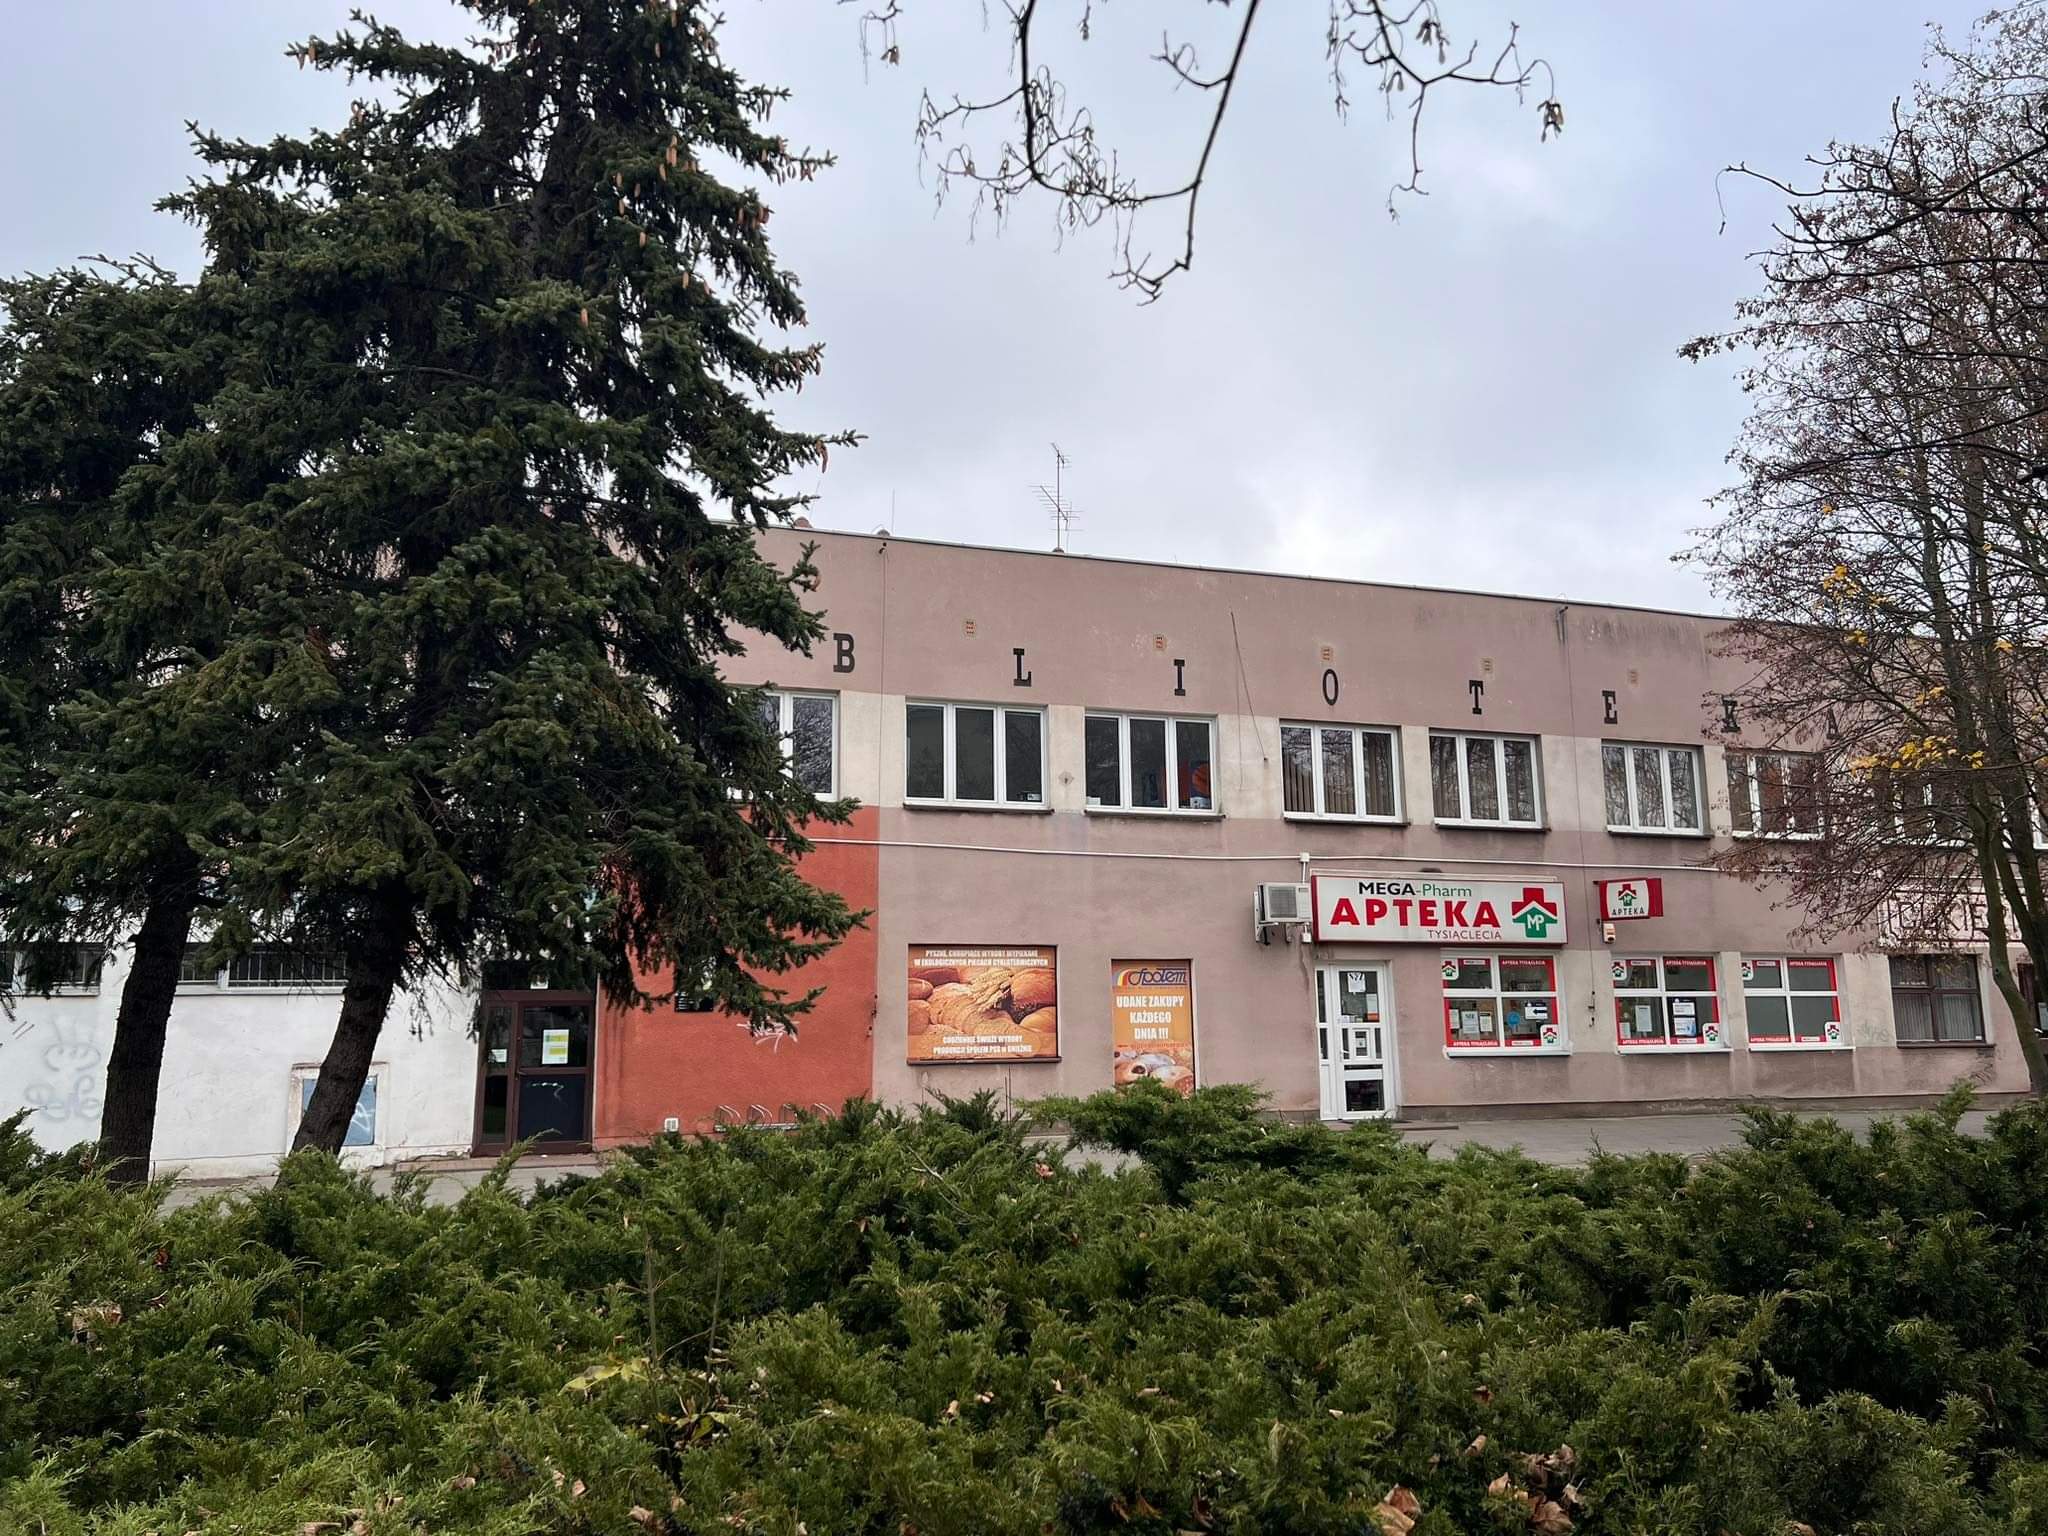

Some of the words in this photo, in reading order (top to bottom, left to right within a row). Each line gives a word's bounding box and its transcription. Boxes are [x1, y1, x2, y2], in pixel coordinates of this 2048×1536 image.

[1358, 882, 1472, 897] MEGA-Pharm
[1330, 897, 1501, 928] APTEKA
[1612, 906, 1645, 916] APTEKA
[1427, 929, 1502, 941] TYSIĄCLECIA
[1116, 995, 1147, 1008] UDANE
[1148, 995, 1184, 1008] ZAKUPY
[1130, 1010, 1171, 1024] KAŻDEGO
[1134, 1027, 1158, 1040] DNIA
